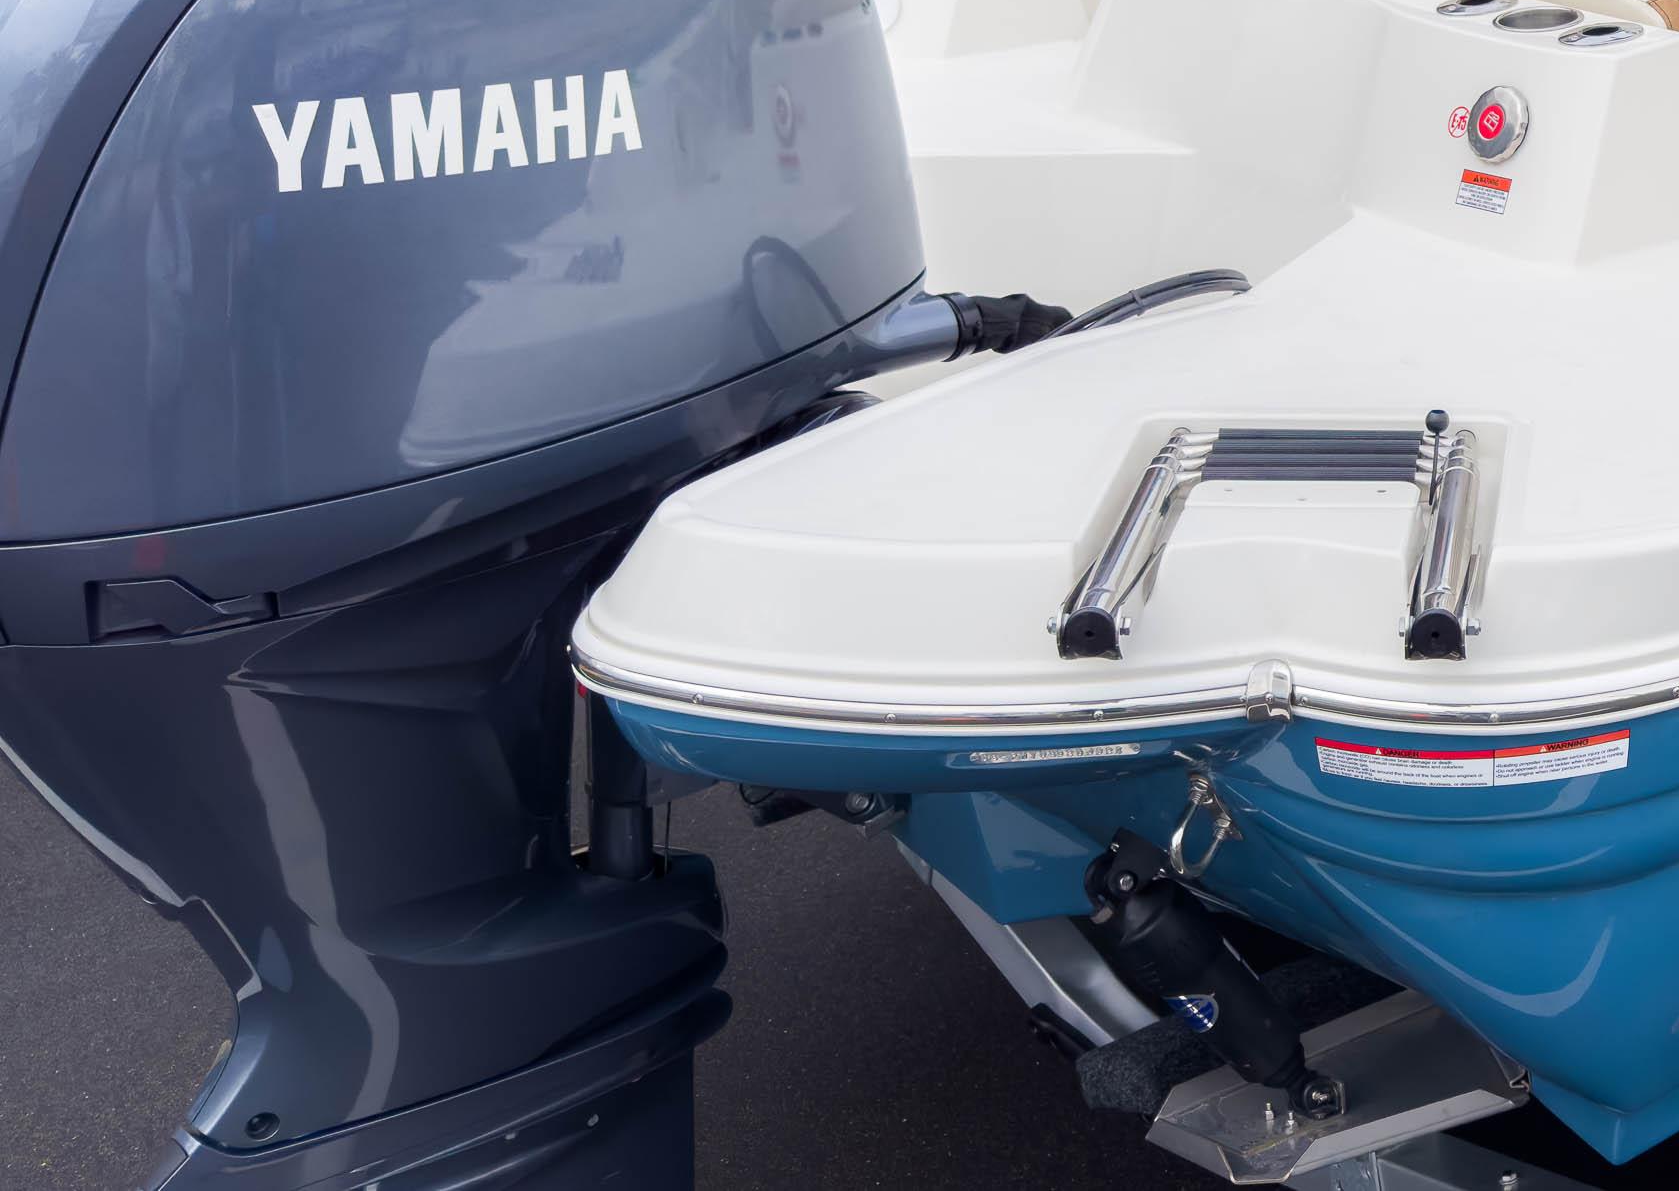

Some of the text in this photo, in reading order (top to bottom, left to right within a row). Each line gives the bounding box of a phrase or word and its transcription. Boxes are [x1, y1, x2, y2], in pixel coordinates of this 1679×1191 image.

[251, 69, 643, 193] YAMAHA
[1547, 739, 1589, 751] WARNING
[1382, 748, 1420, 758] DANGER
